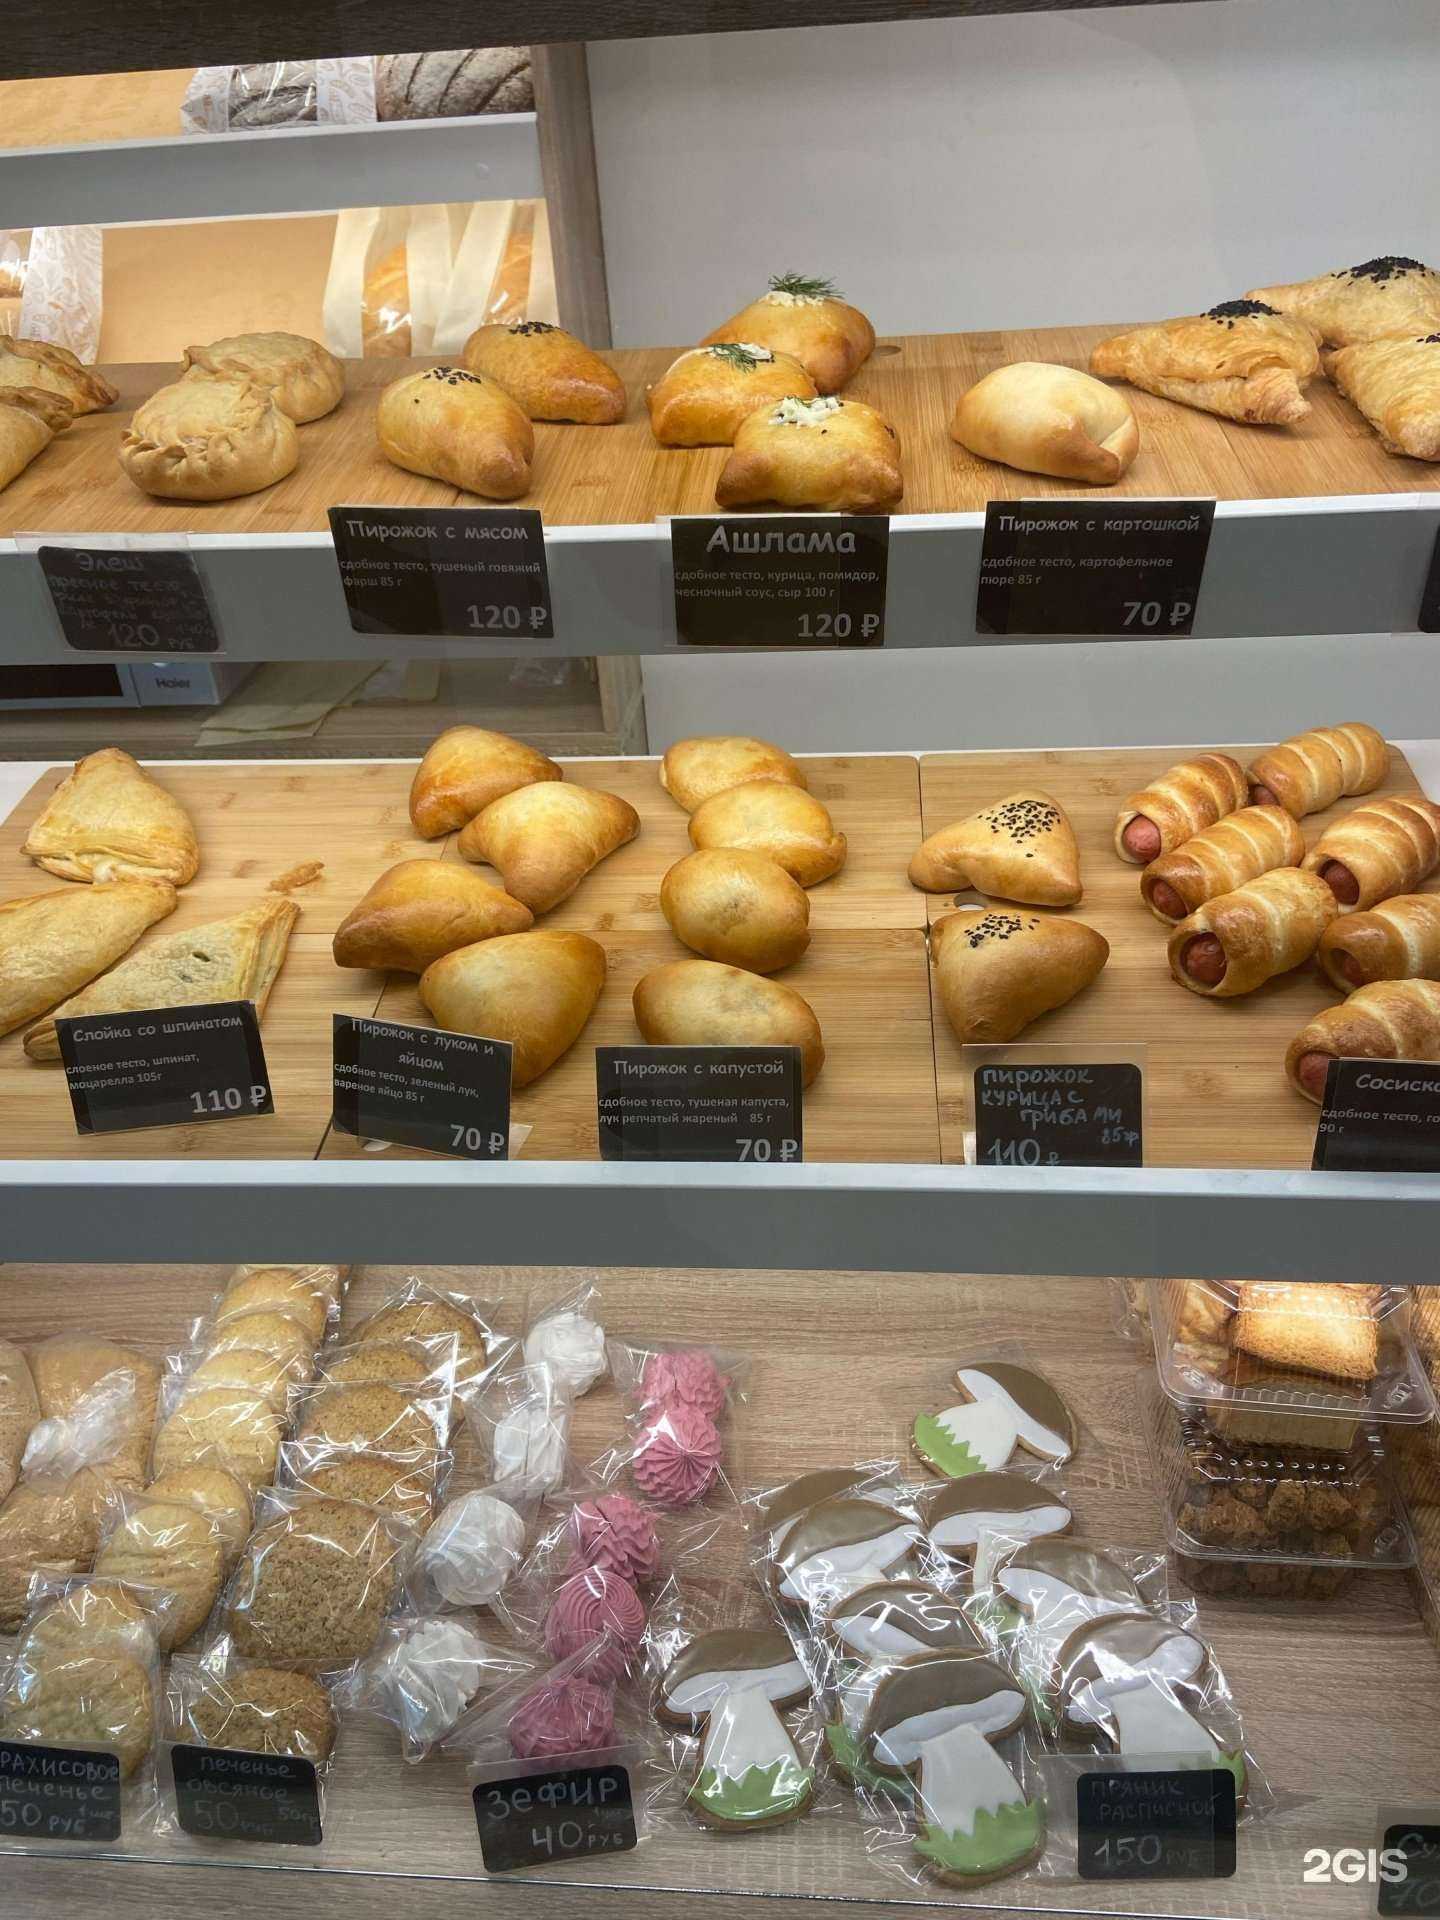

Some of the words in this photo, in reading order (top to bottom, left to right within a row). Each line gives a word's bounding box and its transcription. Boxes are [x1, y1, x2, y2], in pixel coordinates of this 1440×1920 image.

[346, 520, 438, 542] Пирожок
[445, 527, 456, 540] с
[464, 526, 529, 540] мясом
[999, 515, 1079, 536] Пирожок
[1086, 520, 1096, 532] с
[1103, 515, 1200, 536] картошкой
[705, 524, 856, 554] Ашлама
[340, 559, 391, 573] сдобное
[393, 562, 428, 573] тесто,
[431, 561, 485, 574] тушеный
[487, 561, 541, 574] говяжий
[982, 557, 1037, 569] сдобное
[1040, 558, 1076, 568] тесто,
[1079, 556, 1174, 569] картофельное
[343, 576, 377, 588] фарш
[380, 576, 394, 586] 85
[675, 569, 726, 581] сдобное
[729, 571, 764, 582] тесто,
[818, 571, 880, 582] помидор,
[1018, 575, 1034, 585] 85
[676, 587, 742, 597] чесночный
[745, 589, 775, 600] соус,
[777, 589, 800, 600] сыр
[805, 587, 826, 597] 100
[466, 604, 520, 629] 120
[1122, 601, 1162, 627] 70
[108, 624, 160, 648] 120
[797, 613, 851, 638] 120
[155, 677, 191, 689] Haier
[73, 1026, 132, 1043] Слойка
[137, 1025, 156, 1037] со
[162, 1016, 243, 1034] шпинатом
[352, 1019, 415, 1041] Пирожок
[420, 1034, 428, 1044] с
[434, 1036, 478, 1053] луком
[484, 1046, 494, 1056] и
[66, 1062, 114, 1075] слоеное
[116, 1058, 150, 1070] тесто,
[153, 1053, 200, 1066] шпинат,
[398, 1052, 444, 1071] яйцом
[613, 1060, 688, 1078] Пирожок
[693, 1065, 703, 1075] с
[709, 1060, 784, 1078] капустой
[69, 1076, 134, 1091] моцарелла
[137, 1072, 163, 1084] 105г
[335, 1063, 376, 1078] сдобное
[378, 1072, 408, 1086] тесто,
[411, 1078, 456, 1093] зеленый
[458, 1087, 479, 1099] лук,
[335, 1079, 376, 1094] вареное
[378, 1087, 403, 1100] яйцо
[405, 1091, 417, 1102] 85
[190, 1087, 241, 1114] 110
[600, 1096, 648, 1108] сдобное
[650, 1098, 685, 1109] тесто,
[688, 1098, 738, 1109] тушеная
[741, 1098, 790, 1109] капуста,
[600, 1115, 619, 1125] лук
[622, 1113, 679, 1125] репчатый
[682, 1113, 738, 1125] жареный
[750, 1113, 764, 1123] 85
[1322, 1108, 1380, 1121] сдобное
[1383, 1111, 1423, 1125] тесто,
[450, 1123, 481, 1150] 70
[1319, 1123, 1336, 1134] 90
[735, 1138, 771, 1161] 70
[987, 1138, 1041, 1165] 110
[194, 1799, 239, 1832] 50
[532, 1821, 583, 1856] 40
[1094, 1834, 1161, 1866] 150
